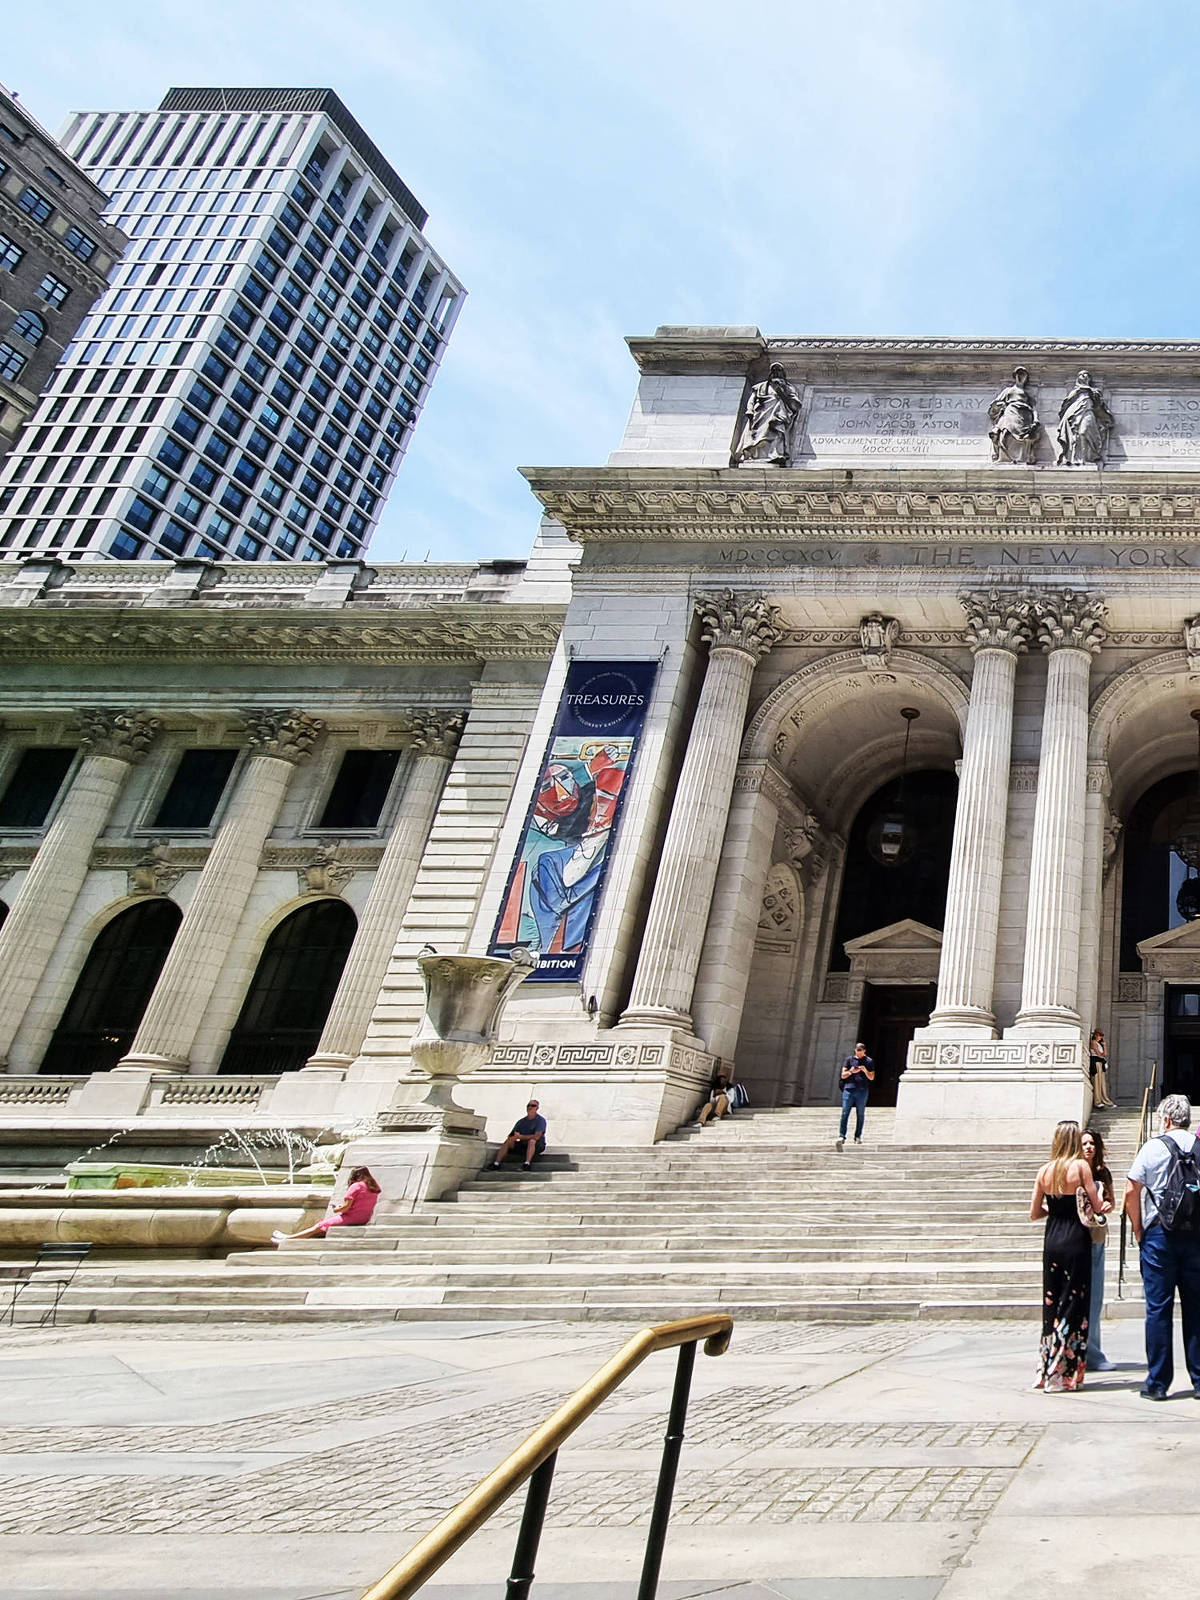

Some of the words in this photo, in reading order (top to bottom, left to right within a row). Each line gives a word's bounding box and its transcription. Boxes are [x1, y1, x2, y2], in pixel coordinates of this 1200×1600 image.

[823, 396, 851, 409] THE
[861, 397, 911, 409] ASTOR
[918, 398, 986, 409] LIBRARY
[1120, 399, 1150, 411] THE
[839, 419, 872, 429] JOHN
[876, 420, 917, 429] JACOB
[922, 420, 961, 429] ASTOR
[1154, 423, 1196, 431] JAMES
[875, 429, 896, 437] FOR
[812, 438, 880, 446] ADVANCEMENT
[1116, 440, 1177, 448] LTERATURE
[909, 546, 976, 566] THE
[999, 547, 1079, 566] NEW
[1109, 548, 1191, 567] YORK
[566, 694, 645, 706] TREASURES
[535, 959, 577, 969] IBITION
